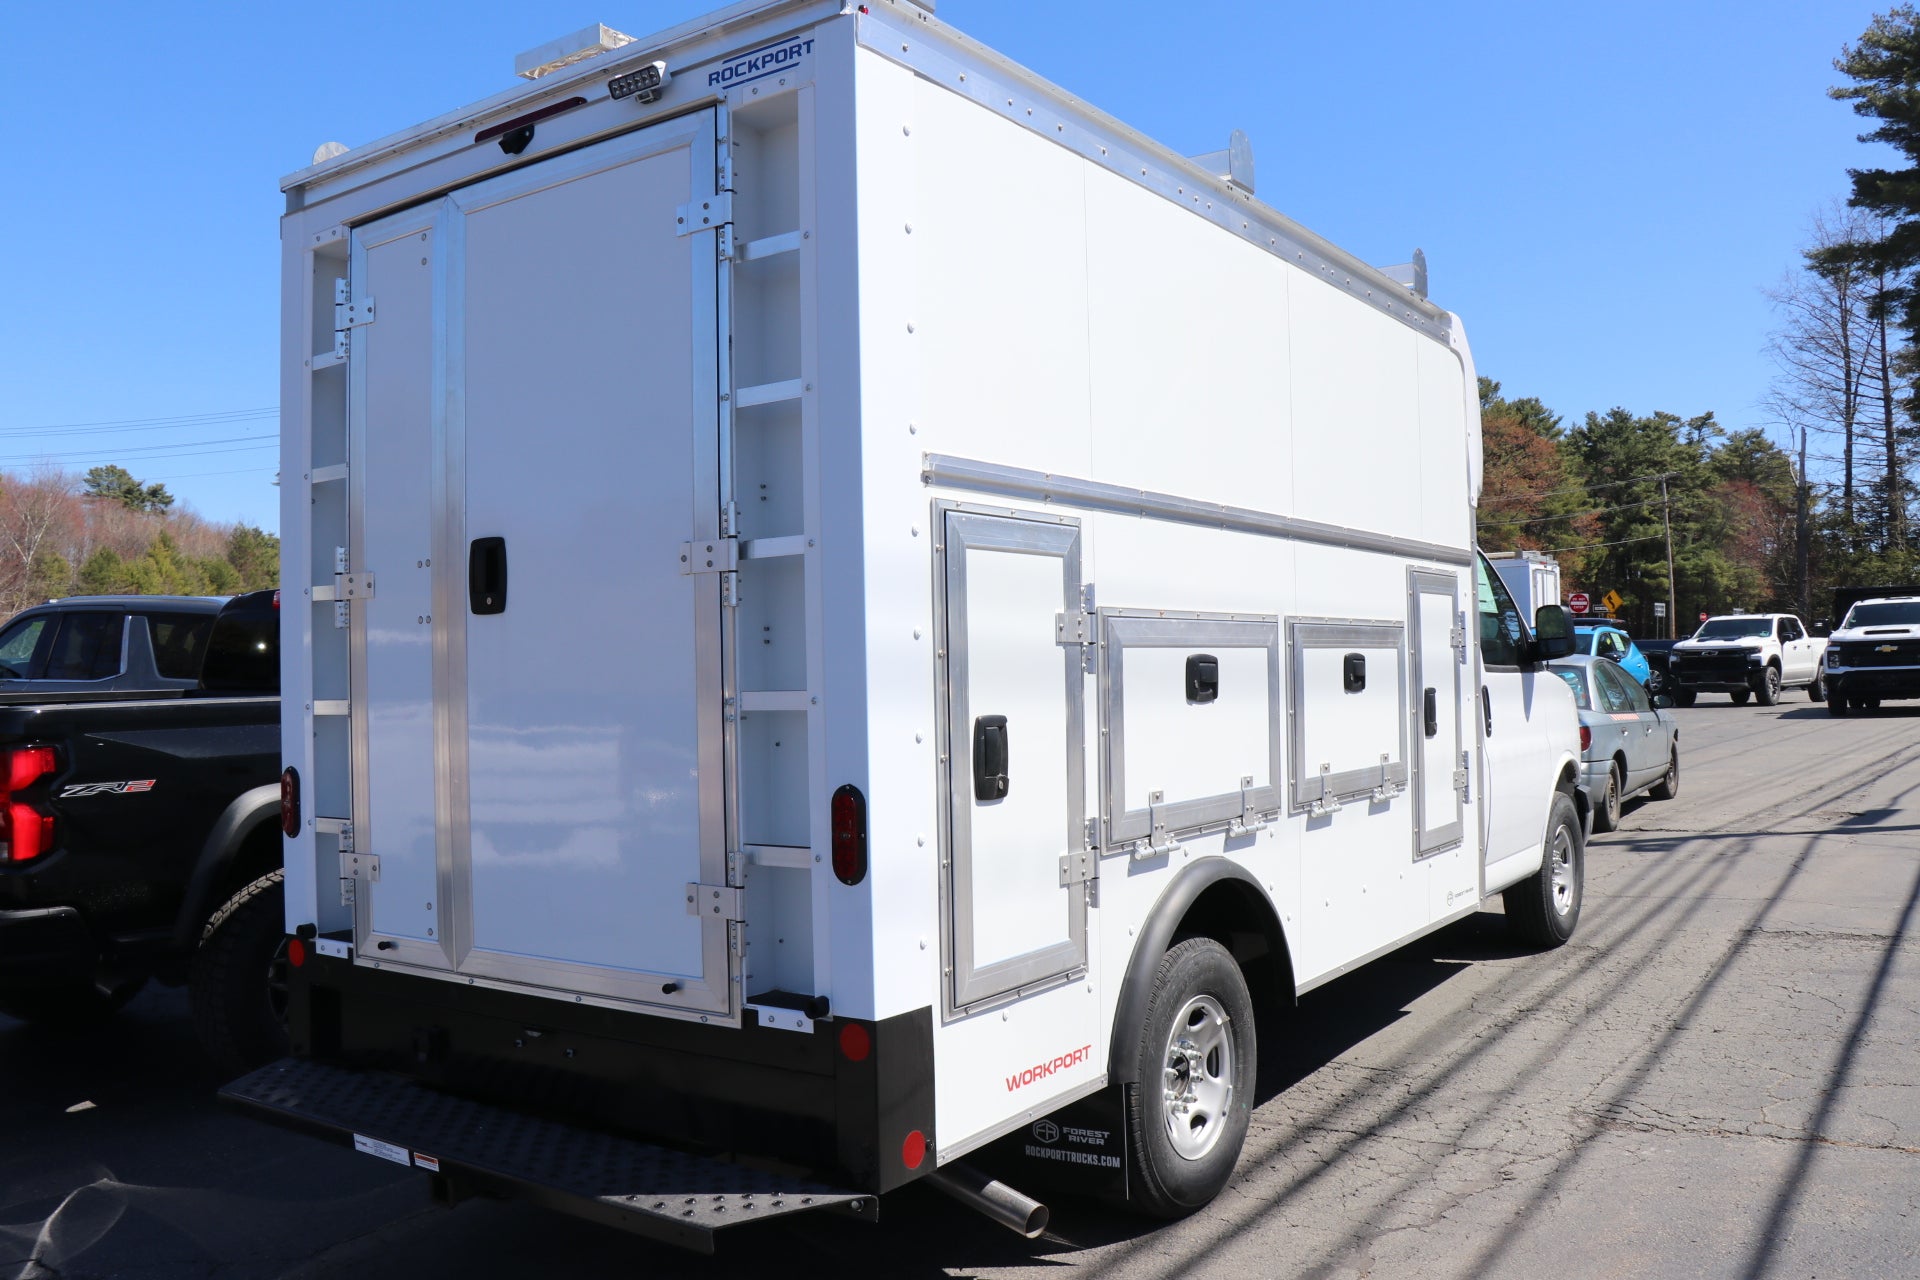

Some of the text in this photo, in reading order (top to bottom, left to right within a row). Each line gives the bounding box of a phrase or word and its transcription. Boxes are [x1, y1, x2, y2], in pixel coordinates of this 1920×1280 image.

[708, 39, 815, 87] ROCKPORT
[60, 779, 156, 798] ZR2
[1006, 1044, 1092, 1092] WORKPORT
[1062, 1126, 1110, 1139] FOREST
[1068, 1134, 1105, 1146] RIVER
[1025, 1144, 1121, 1168] ROCKPORTTRUCKS.COM
